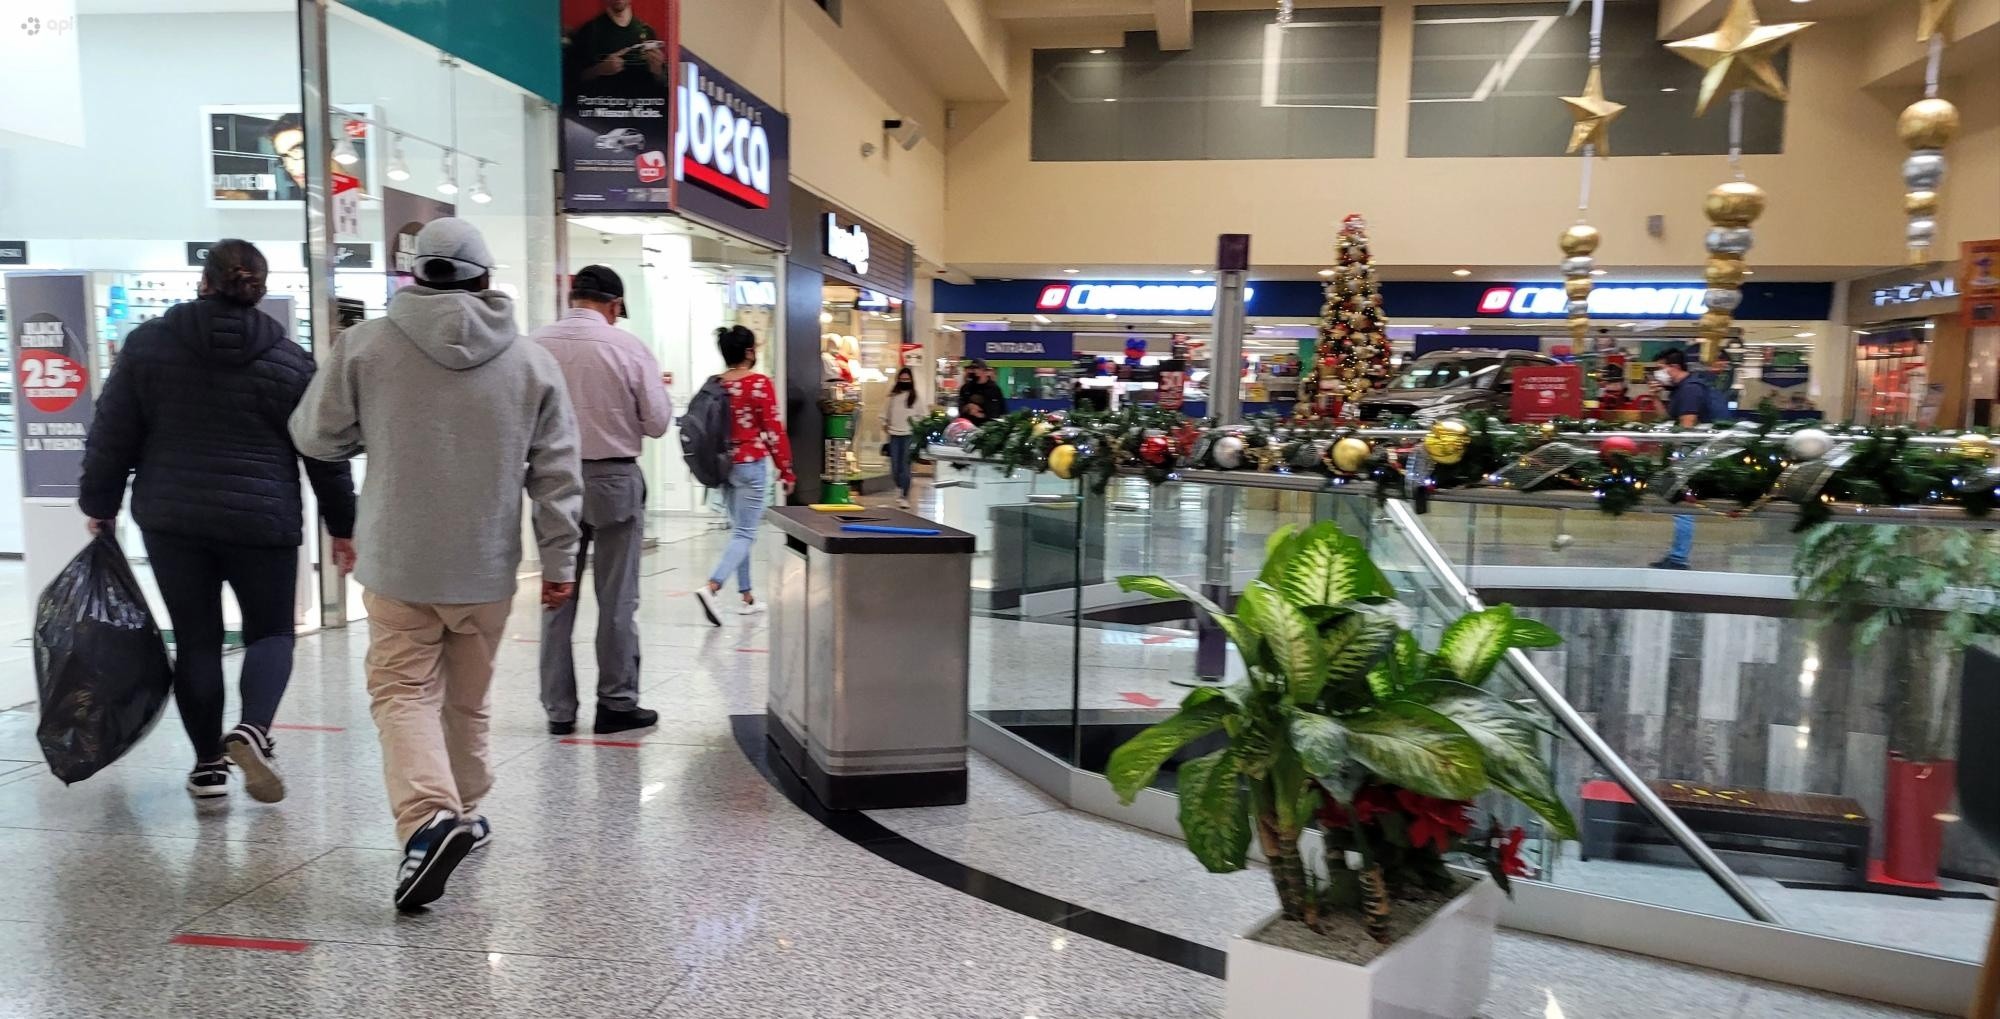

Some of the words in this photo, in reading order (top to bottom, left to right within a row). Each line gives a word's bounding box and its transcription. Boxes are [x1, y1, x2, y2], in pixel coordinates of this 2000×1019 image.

[985, 342, 1046, 353] ENTRADA
[27, 422, 46, 436] EN
[47, 422, 87, 436] TODA
[23, 438, 43, 451] LA
